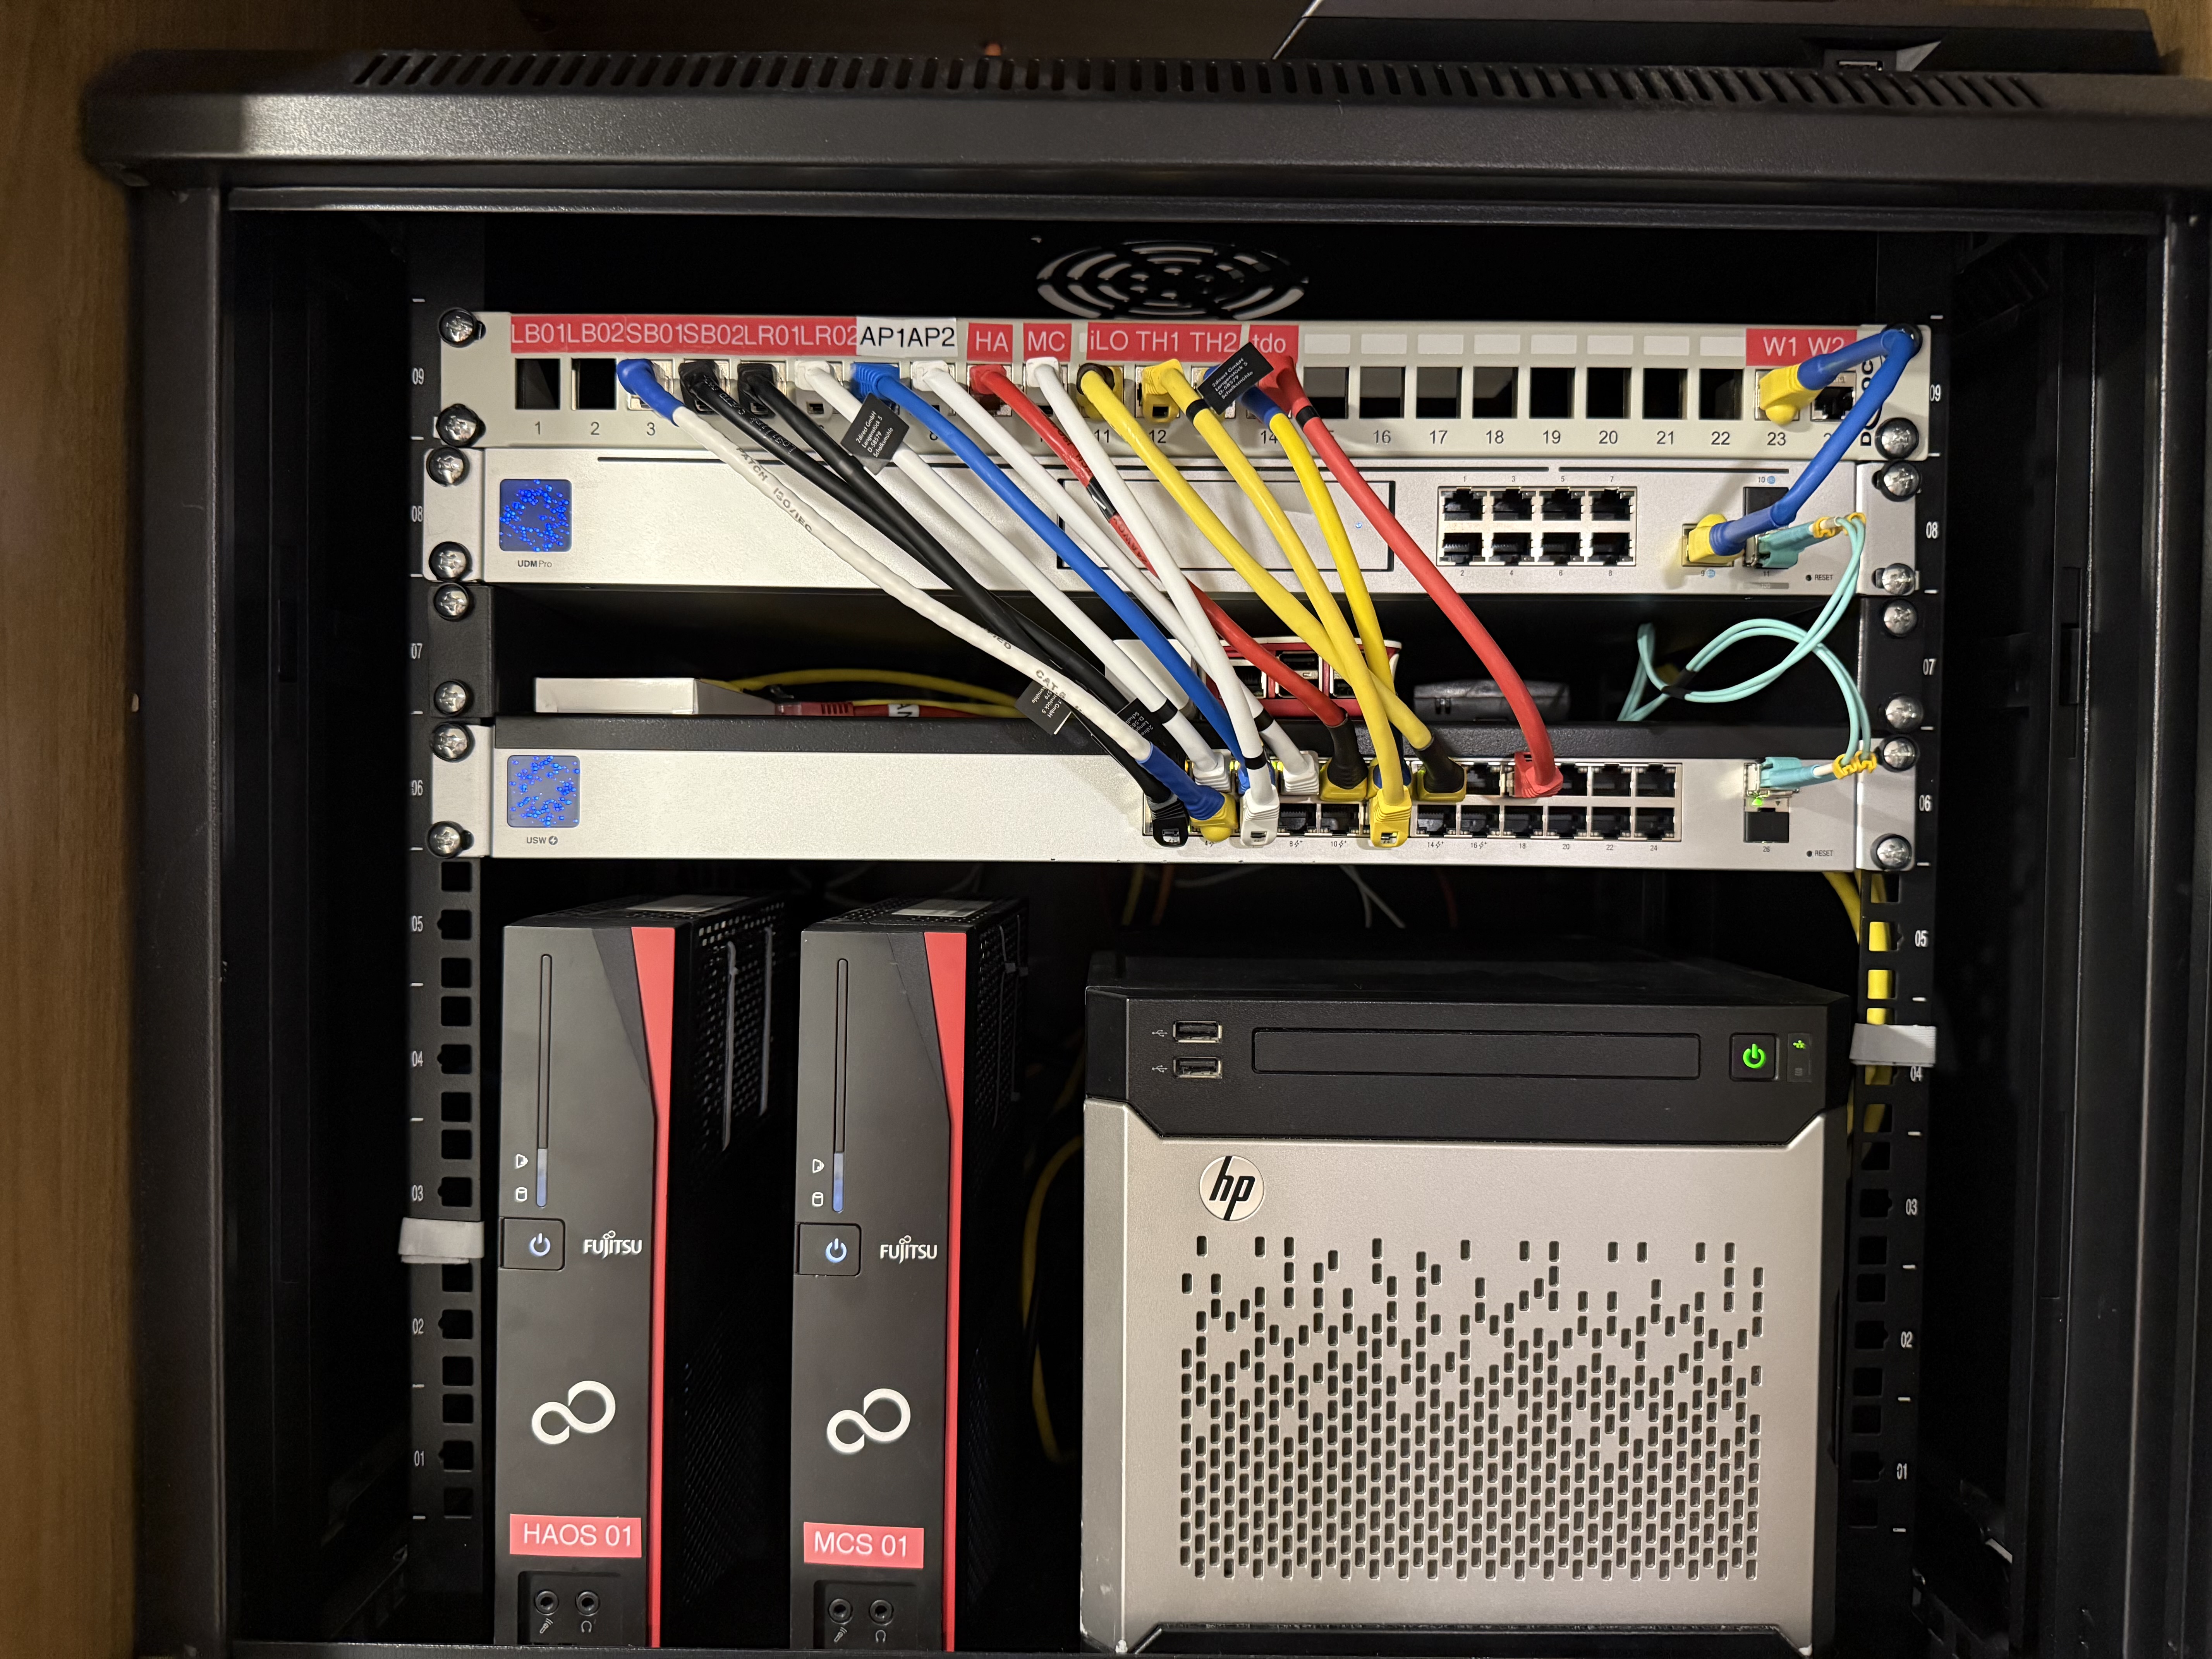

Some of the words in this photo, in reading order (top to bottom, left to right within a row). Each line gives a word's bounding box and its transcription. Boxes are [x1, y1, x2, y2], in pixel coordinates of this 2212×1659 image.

[512, 323, 566, 343] LB01
[568, 323, 624, 343] LB02
[627, 322, 683, 344] SB01
[684, 323, 743, 345] SB02
[745, 325, 798, 345] LR01
[802, 325, 857, 347] LR02
[860, 326, 904, 348] AP1
[908, 327, 955, 348] AP2
[976, 331, 1008, 352] HA
[1028, 331, 1065, 352] MC
[1091, 330, 1128, 352] iLO
[1136, 331, 1179, 352] TH1
[1190, 331, 1237, 352] TH2
[1764, 337, 1796, 357] W1
[1808, 337, 1845, 356] W2
[412, 368, 424, 385] 09
[1930, 384, 1941, 402] 09
[866, 410, 877, 427] GmbH
[535, 421, 540, 435] 1
[591, 421, 599, 435] 2
[646, 422, 656, 436] 3
[1094, 429, 1109, 443] 11
[1149, 429, 1166, 443] 12
[1374, 429, 1391, 443] 16
[1429, 430, 1448, 444] 17
[1486, 430, 1504, 444] 18
[1543, 430, 1561, 444] 19
[1599, 430, 1618, 444] 20
[1657, 431, 1673, 445] 21
[1711, 431, 1730, 445] 22
[1767, 432, 1786, 446] 23
[411, 505, 423, 522] 08
[1926, 522, 1938, 539] 08
[411, 643, 423, 659] 07
[1923, 658, 1936, 675] 07
[411, 780, 423, 796] 06
[1919, 795, 1931, 812] 06
[412, 915, 423, 932] 05
[1915, 930, 1927, 947] 05
[412, 1050, 424, 1067] 04
[1910, 1067, 1922, 1082] 04
[412, 1185, 423, 1201] 03
[1906, 1198, 1917, 1215] 03
[582, 1230, 642, 1259] FUJITSU
[880, 1235, 937, 1264] FUJITSU
[412, 1318, 424, 1334] 02
[1901, 1331, 1913, 1348] 02
[414, 1450, 424, 1467] 01
[1896, 1463, 1907, 1480] 01
[524, 1523, 597, 1546] HAOS
[605, 1525, 632, 1546] 01
[814, 1531, 873, 1555] MCS
[881, 1535, 906, 1557] 01
